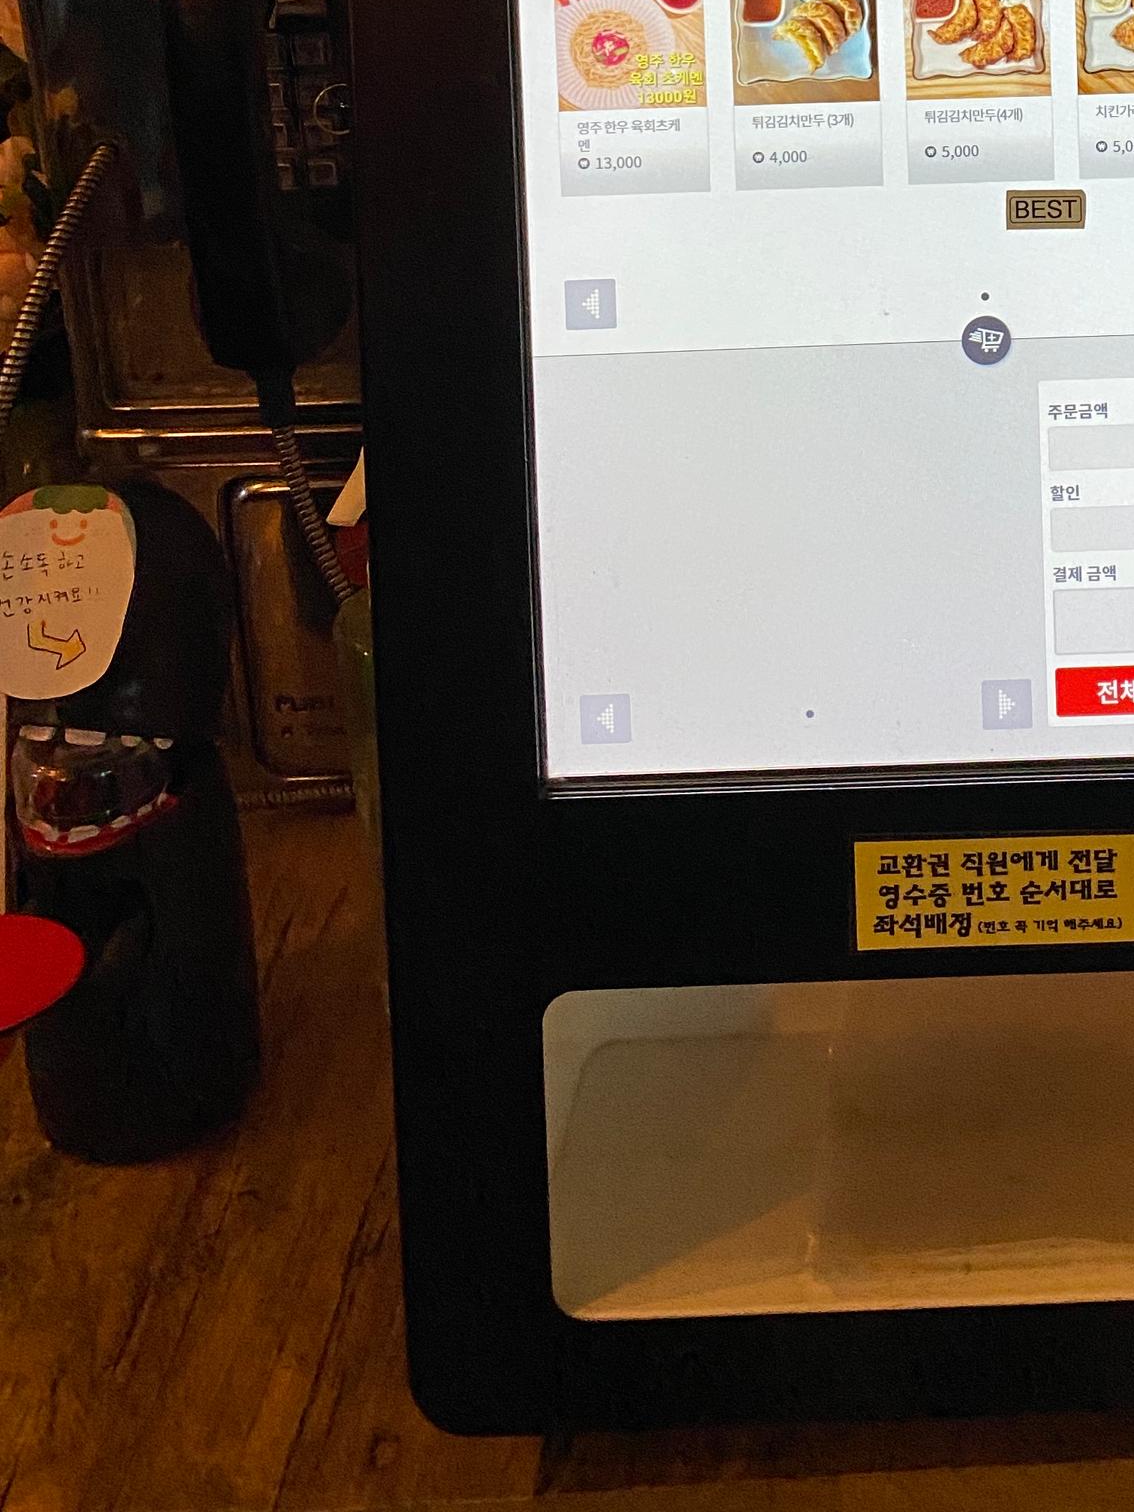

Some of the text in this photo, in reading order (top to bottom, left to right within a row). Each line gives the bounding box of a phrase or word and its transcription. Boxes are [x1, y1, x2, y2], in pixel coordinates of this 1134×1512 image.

[634, 52, 696, 70] 영주 한우
[637, 89, 697, 105] 13000원
[752, 112, 855, 129] 튀김김치만두 (3개)
[924, 106, 1023, 124] 튀김김치만두(4개)
[577, 118, 681, 135] 영주 한우 육회츠케
[578, 138, 591, 153] 멘
[941, 144, 979, 161] 5,000
[594, 155, 642, 171] 13,000
[769, 150, 808, 165] 4,000
[1014, 199, 1078, 220] BEST
[1047, 402, 1109, 421] 주문금액
[1050, 484, 1081, 502] 할인
[1052, 564, 1117, 583] 결제 금액
[877, 847, 1118, 877] 교환권 직원에게 전달
[878, 879, 1118, 909] 영수증 번호 순서대로
[873, 911, 1059, 938] 좌석배정 (번호 기억
